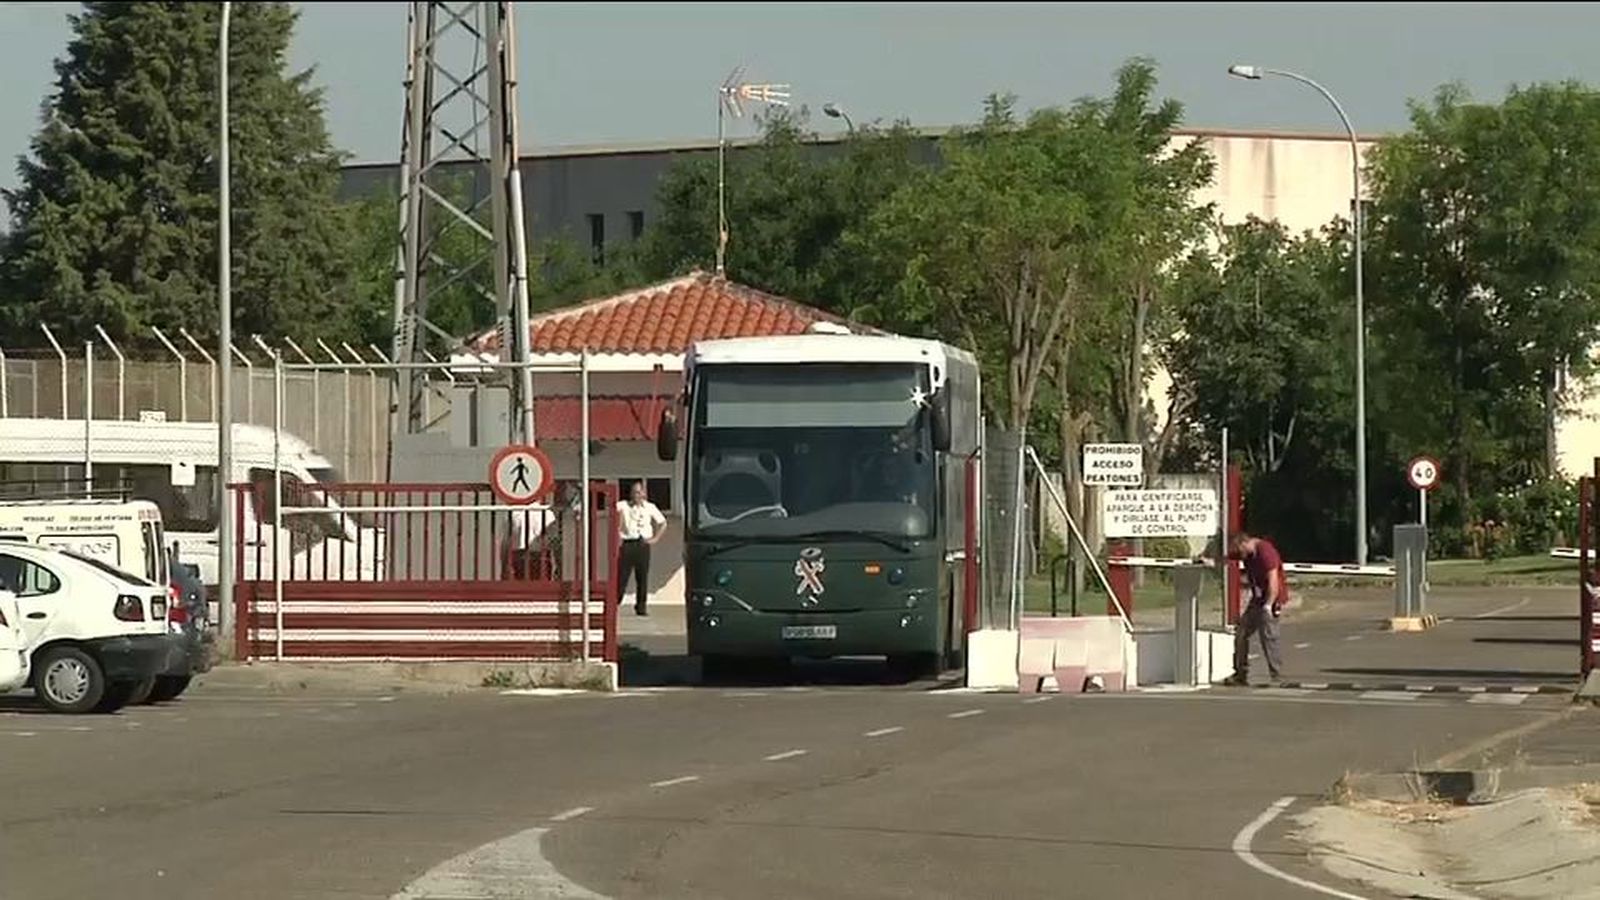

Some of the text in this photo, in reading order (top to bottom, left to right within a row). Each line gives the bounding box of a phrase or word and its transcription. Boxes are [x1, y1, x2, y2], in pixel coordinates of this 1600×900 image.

[1085, 446, 1141, 455] PROHIBIDO
[1092, 460, 1134, 469] ACCESO
[1415, 467, 1434, 479] 40
[1086, 474, 1140, 483] PEATONES
[1115, 493, 1138, 502] PARA
[1106, 503, 1213, 513] APARQUE A LA DERECHA
[1164, 514, 1175, 523] AL
[1178, 513, 1208, 523] PUNTO
[1131, 524, 1188, 534] DE CONTROL
